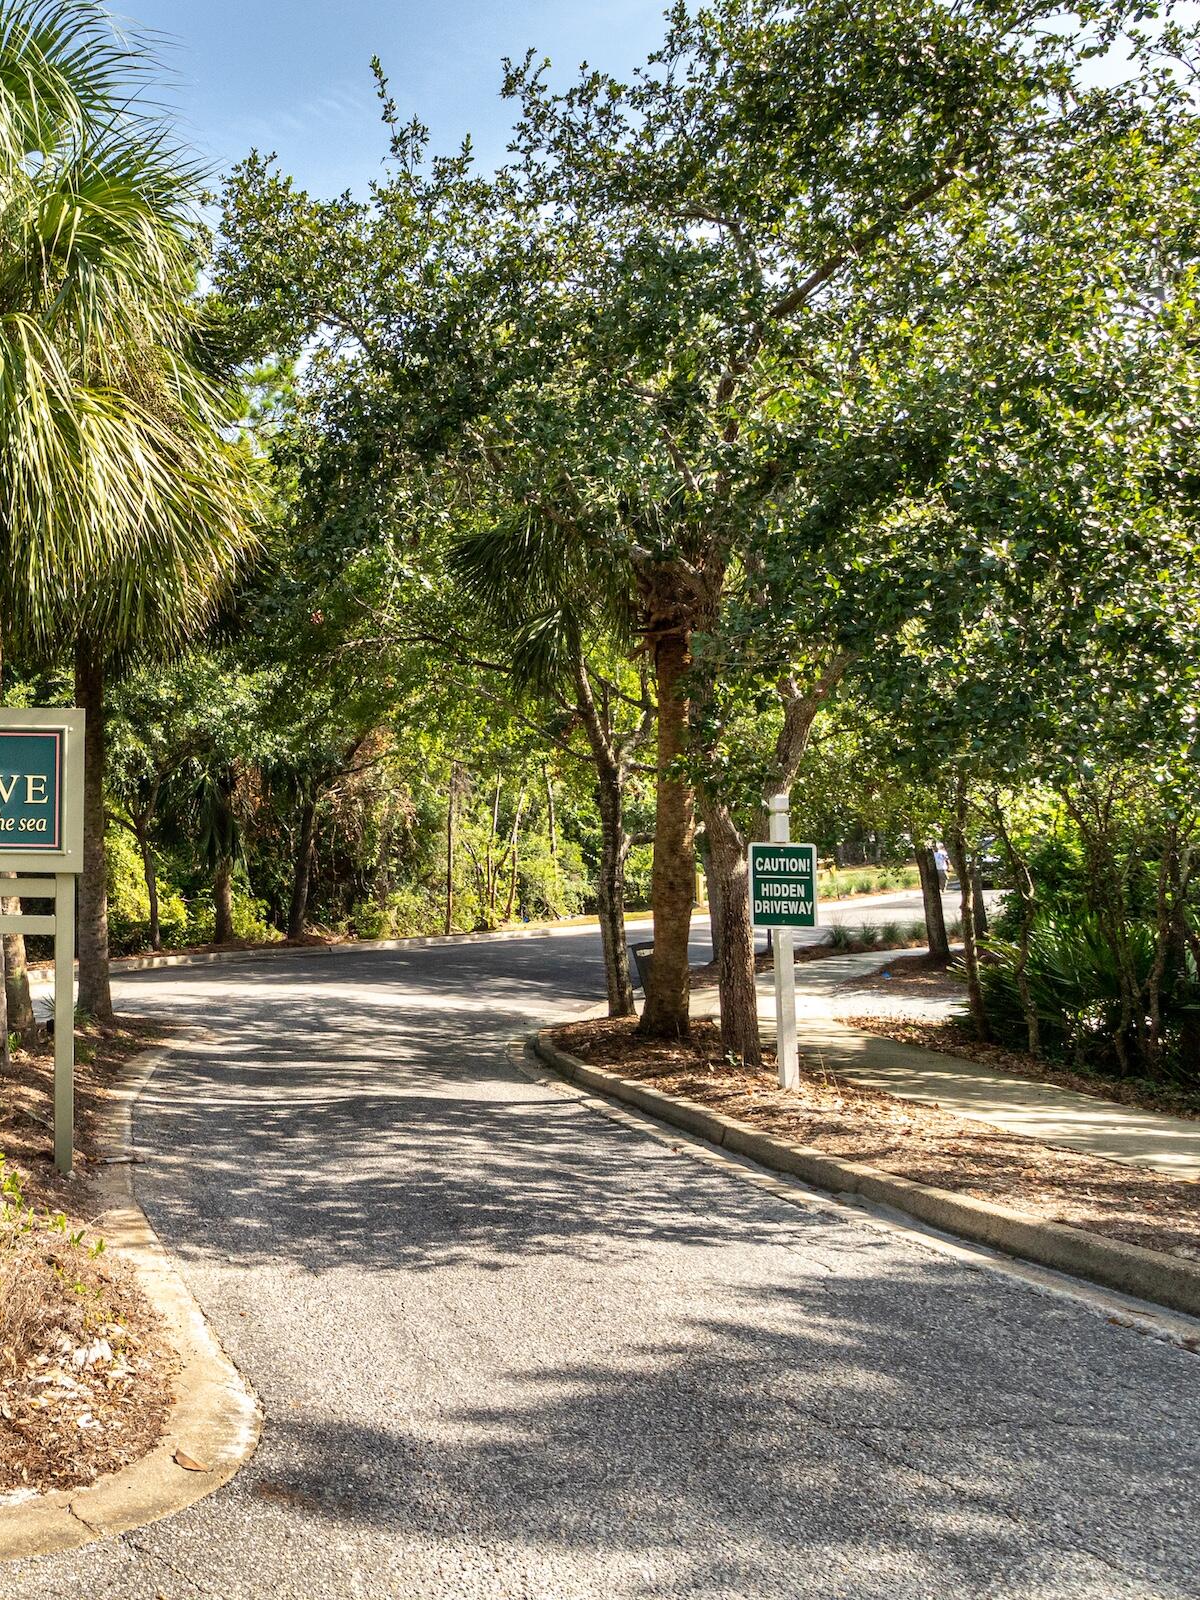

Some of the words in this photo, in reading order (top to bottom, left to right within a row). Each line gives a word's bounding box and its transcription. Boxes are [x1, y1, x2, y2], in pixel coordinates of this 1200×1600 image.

[18, 817, 47, 832] sea
[755, 857, 810, 872] CAUTION!
[761, 883, 805, 898] HIDDEN
[754, 900, 813, 915] DRIVEWAY
